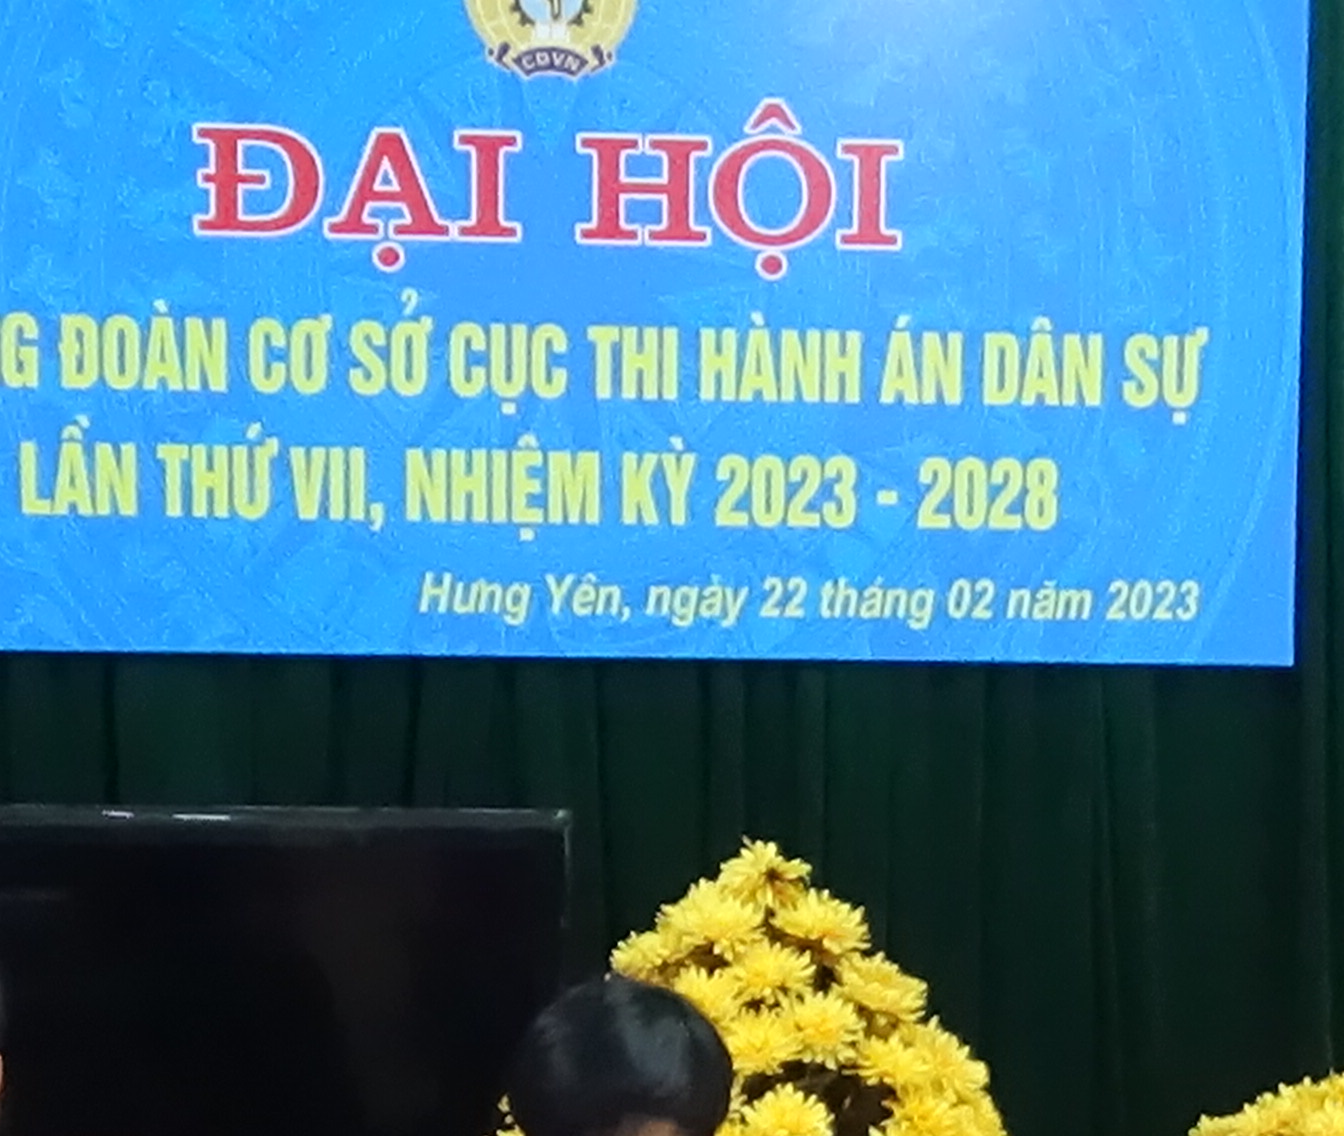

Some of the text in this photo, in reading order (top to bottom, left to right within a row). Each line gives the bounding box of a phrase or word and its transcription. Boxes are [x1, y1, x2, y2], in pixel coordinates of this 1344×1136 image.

[192, 98, 905, 278] ĐẠI HỘI
[58, 298, 229, 393] ĐOÀN
[248, 313, 332, 395] CƠ
[348, 288, 433, 396] SỞ
[448, 321, 568, 416] CỤC
[586, 324, 679, 400] THI
[699, 309, 862, 404] HÀNH
[879, 314, 963, 405] ÁN
[982, 316, 1103, 407] DÂN
[1122, 326, 1210, 426] SỰ
[18, 413, 1059, 542] LẦN THỨ VII, NHIỆM KỲ 2023 - 2028
[418, 571, 1201, 631] Hưng Yên, ngày 22 tháng 02 năm 2023
